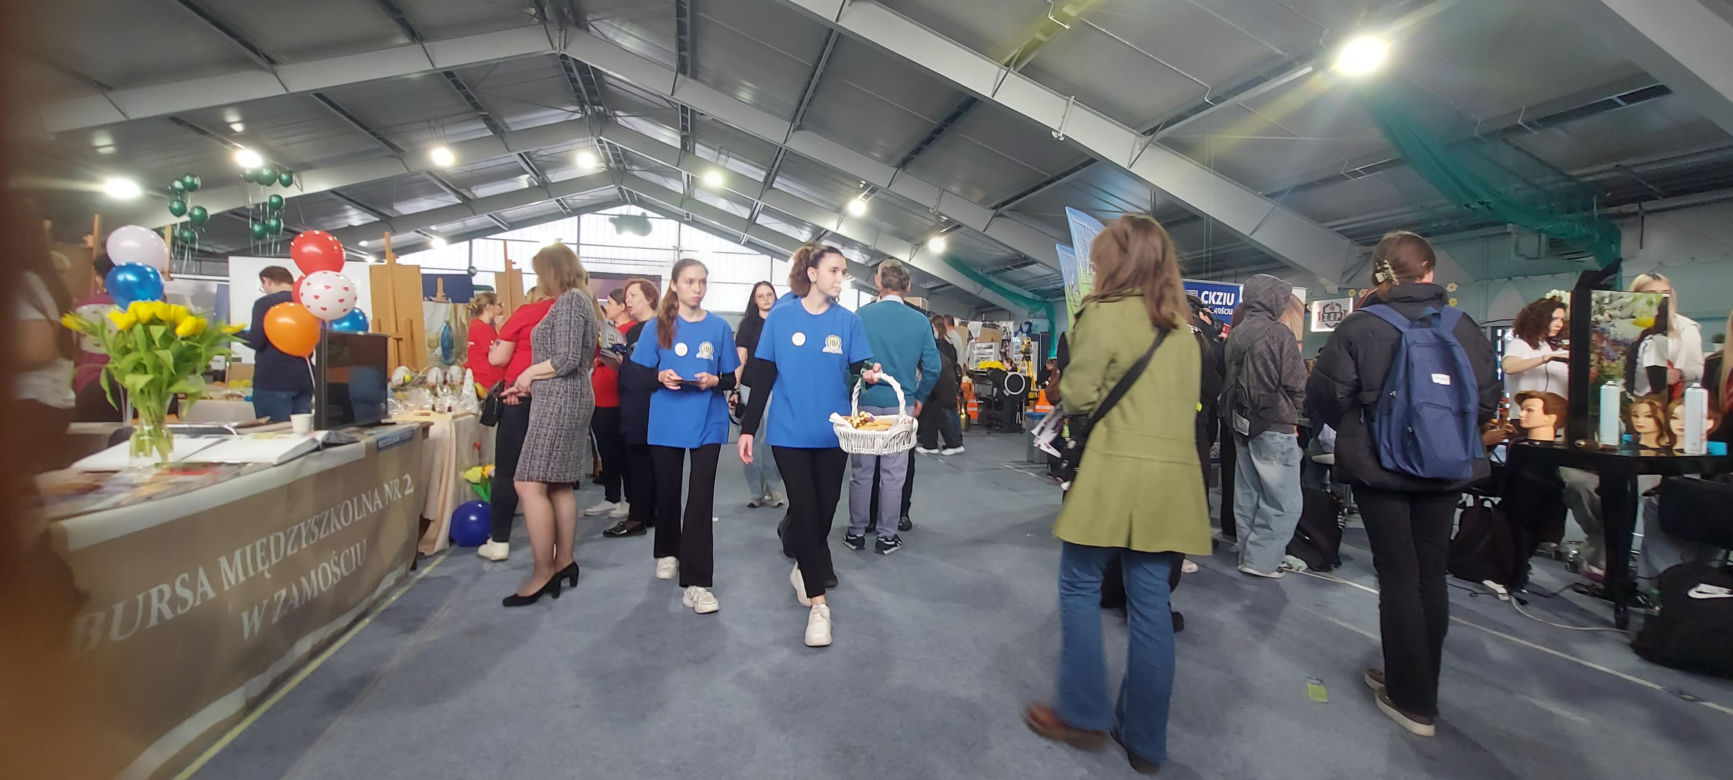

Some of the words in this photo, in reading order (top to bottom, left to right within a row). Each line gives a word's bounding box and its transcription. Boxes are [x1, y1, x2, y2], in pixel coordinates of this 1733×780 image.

[1200, 290, 1235, 306] CKZIU
[72, 565, 216, 652] BURSA
[217, 487, 383, 591] MIĘDZYSZKOLNA
[384, 478, 402, 505] NR
[402, 474, 415, 495] 2
[241, 598, 268, 641] W
[272, 538, 368, 625] ZAMOŚCIU
